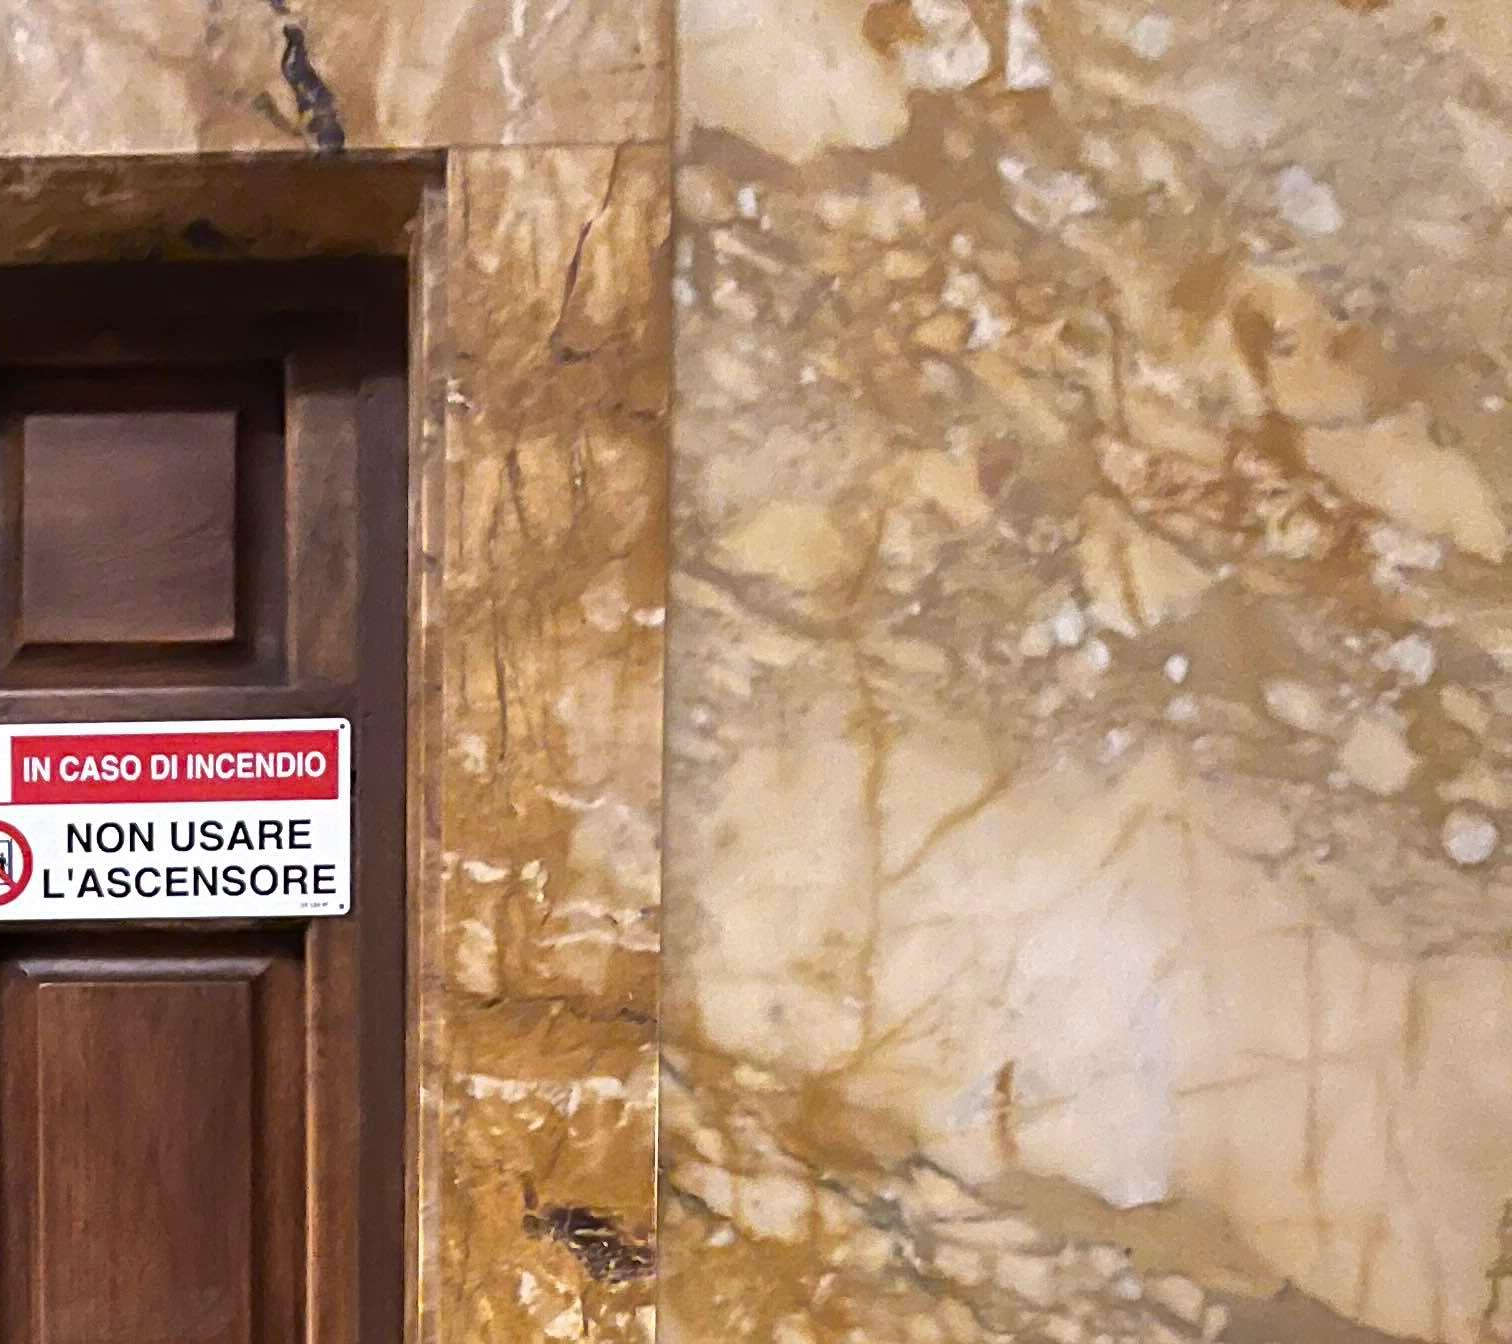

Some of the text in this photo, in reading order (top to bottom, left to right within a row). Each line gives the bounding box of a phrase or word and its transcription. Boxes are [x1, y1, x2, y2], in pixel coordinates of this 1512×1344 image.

[22, 750, 327, 783] IN CASO DI INCENDIO
[66, 818, 313, 853] NON USARE
[41, 863, 337, 899] L'ASCENSORE
